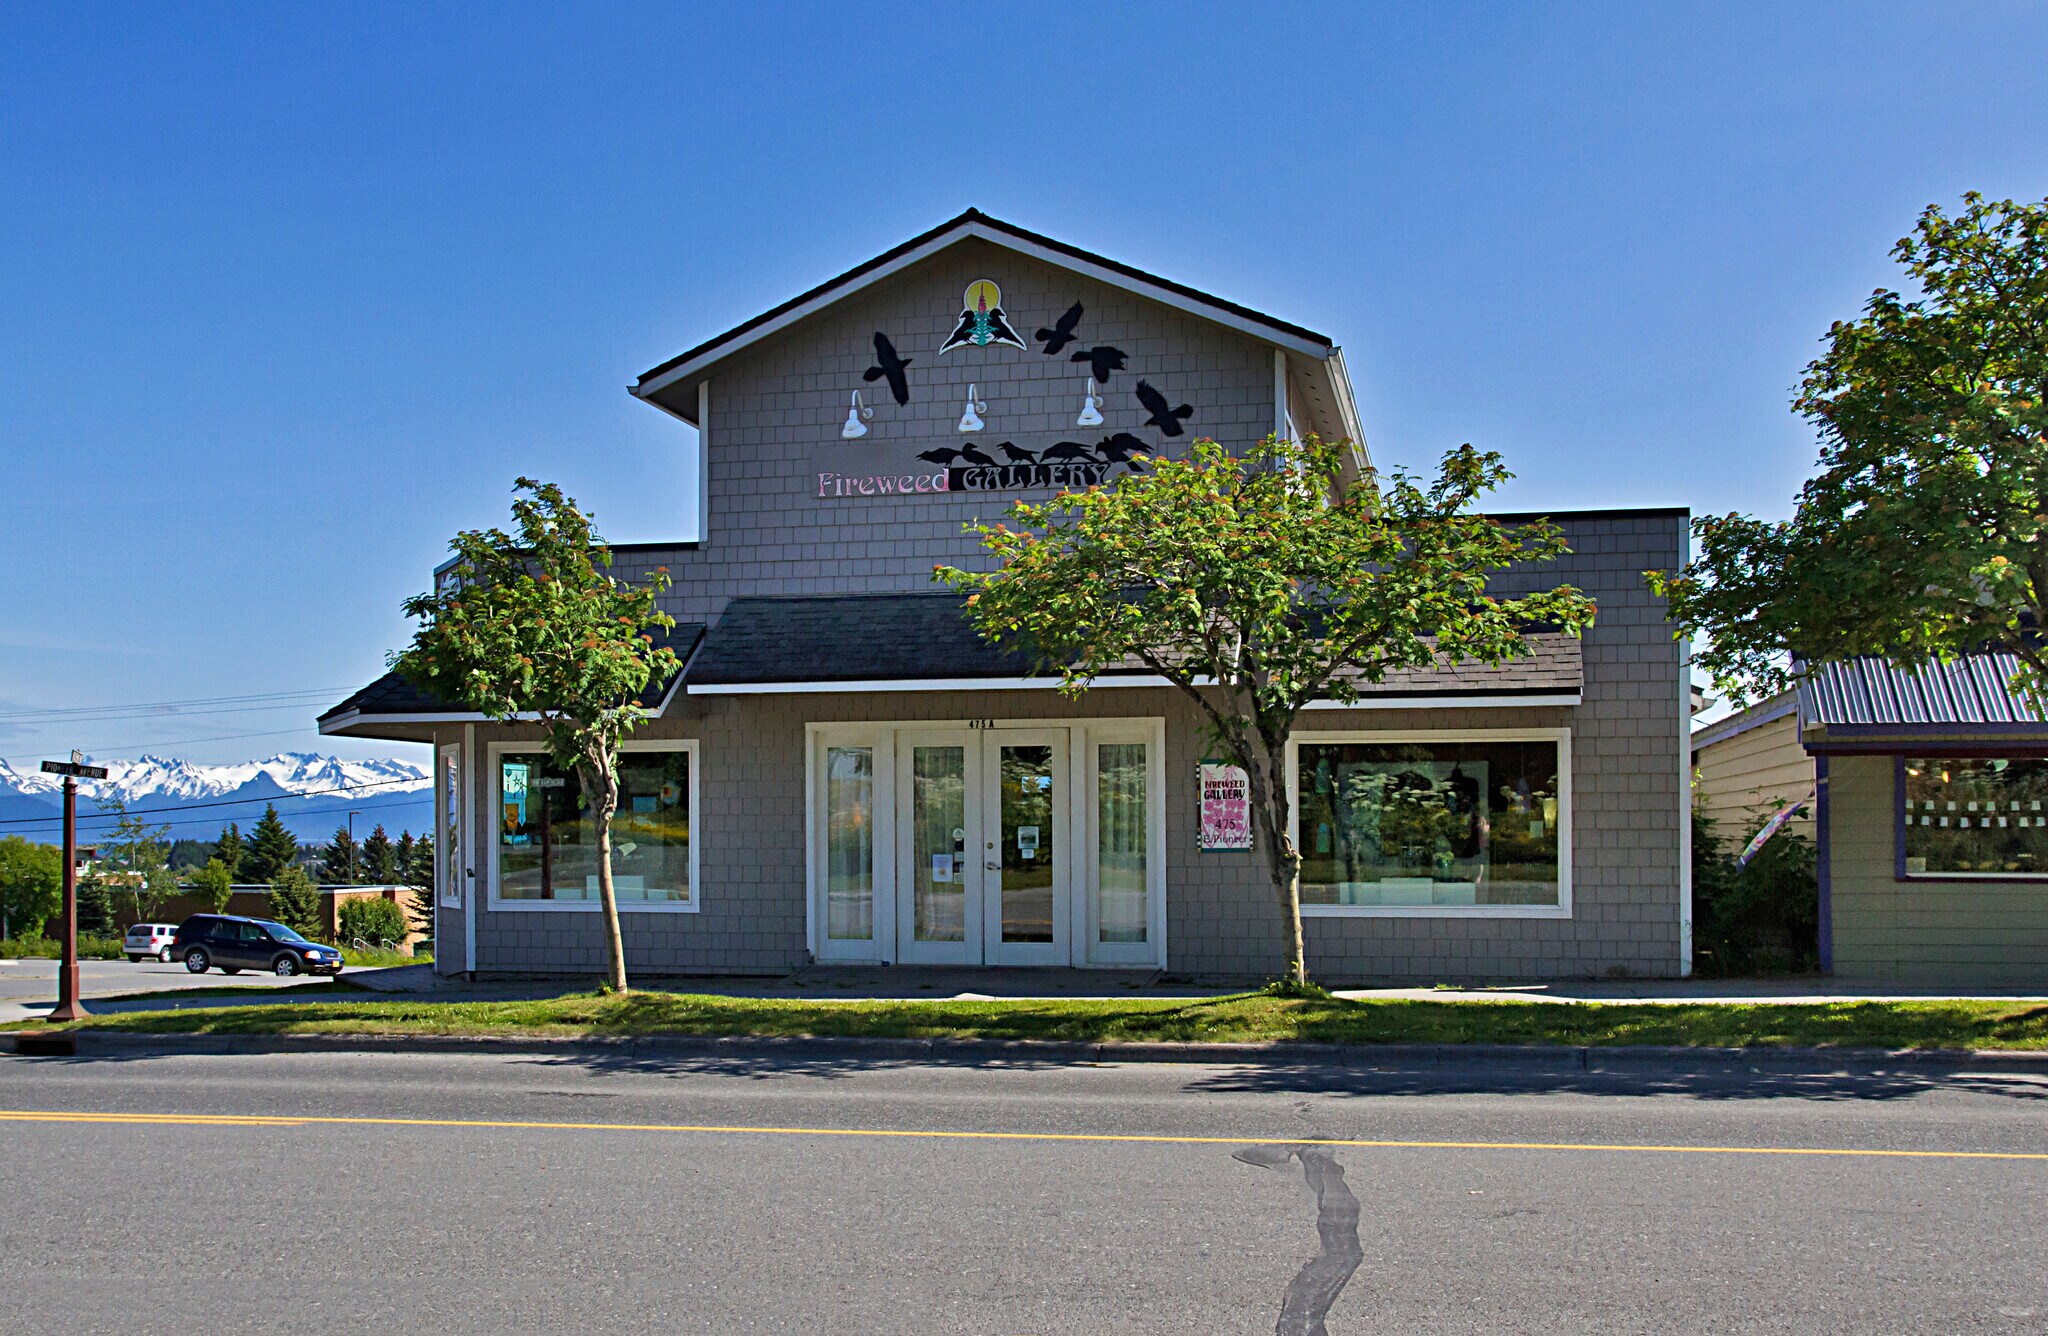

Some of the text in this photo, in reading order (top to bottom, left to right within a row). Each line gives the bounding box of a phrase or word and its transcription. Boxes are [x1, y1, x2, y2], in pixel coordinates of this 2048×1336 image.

[818, 463, 1111, 496] Fireweed GALLERY
[969, 720, 994, 728] 475 A
[79, 767, 103, 777] AVENUE
[1205, 780, 1245, 789] FIREWEED
[1204, 789, 1246, 801] GALLERY
[1215, 819, 1236, 829] 475
